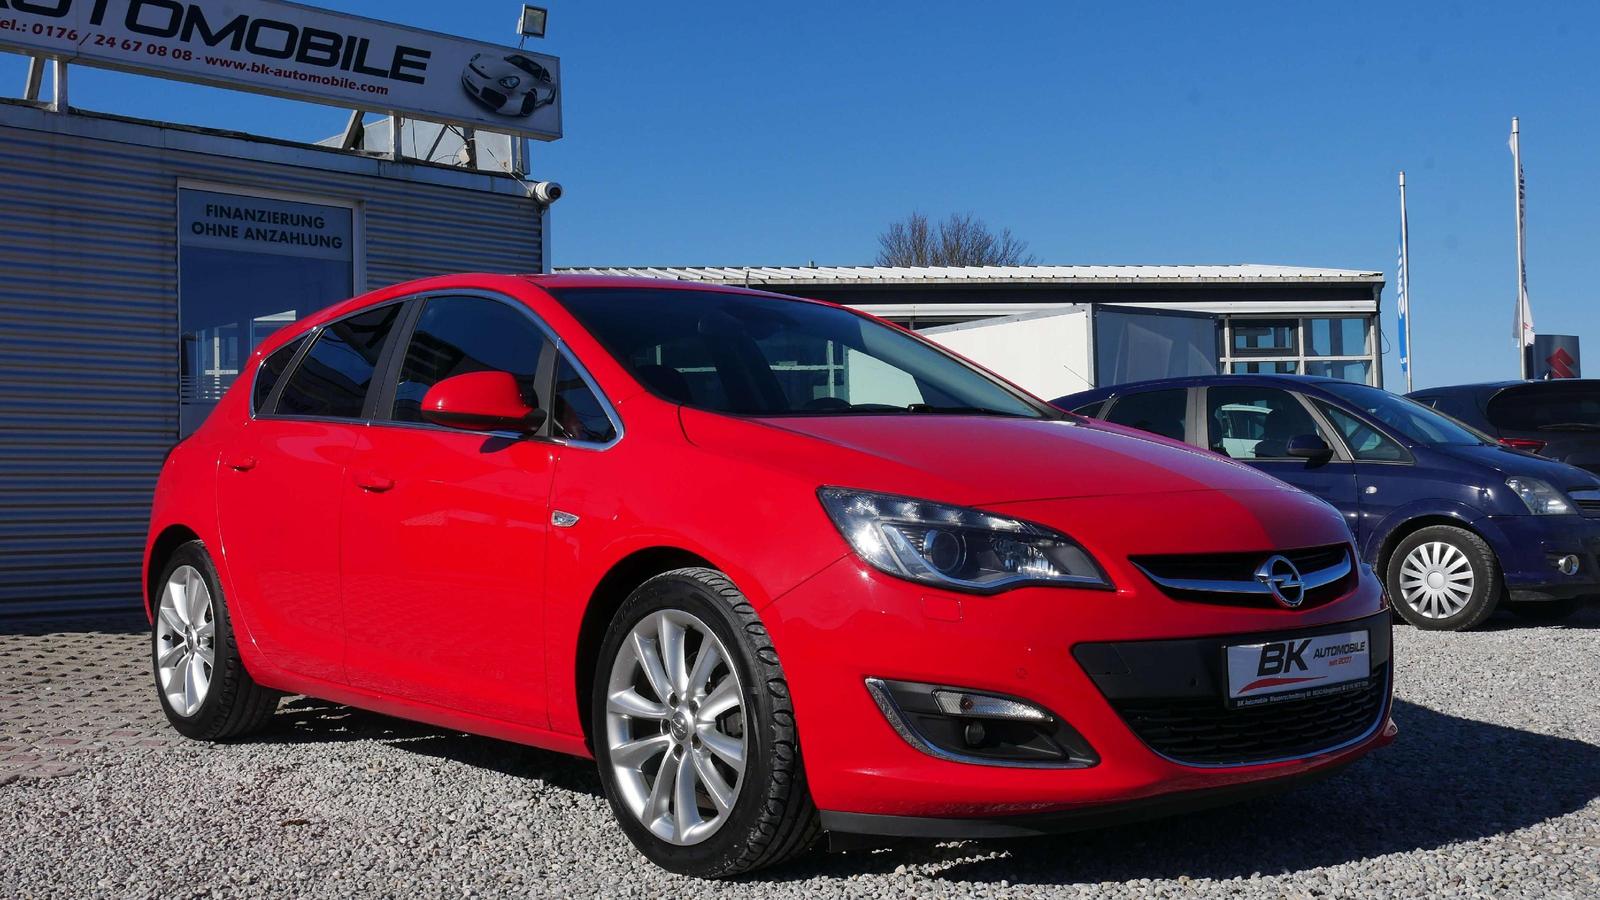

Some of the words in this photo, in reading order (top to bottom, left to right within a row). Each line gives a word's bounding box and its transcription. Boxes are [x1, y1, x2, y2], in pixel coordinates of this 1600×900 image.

[0, 0, 432, 85] UTOMOBILE
[0, 18, 27, 33] el.:
[94, 34, 117, 48] 24
[120, 38, 142, 52] 67
[146, 43, 168, 57] 08
[171, 48, 193, 61] 08
[205, 54, 389, 96] www.bk-automobile.com
[191, 221, 239, 238] OHNE
[244, 227, 343, 249] ANZAHLUNG
[205, 204, 325, 229] FINANZIERUNG
[1256, 639, 1313, 677] BK
[1313, 641, 1366, 659] AUTOMOBILE
